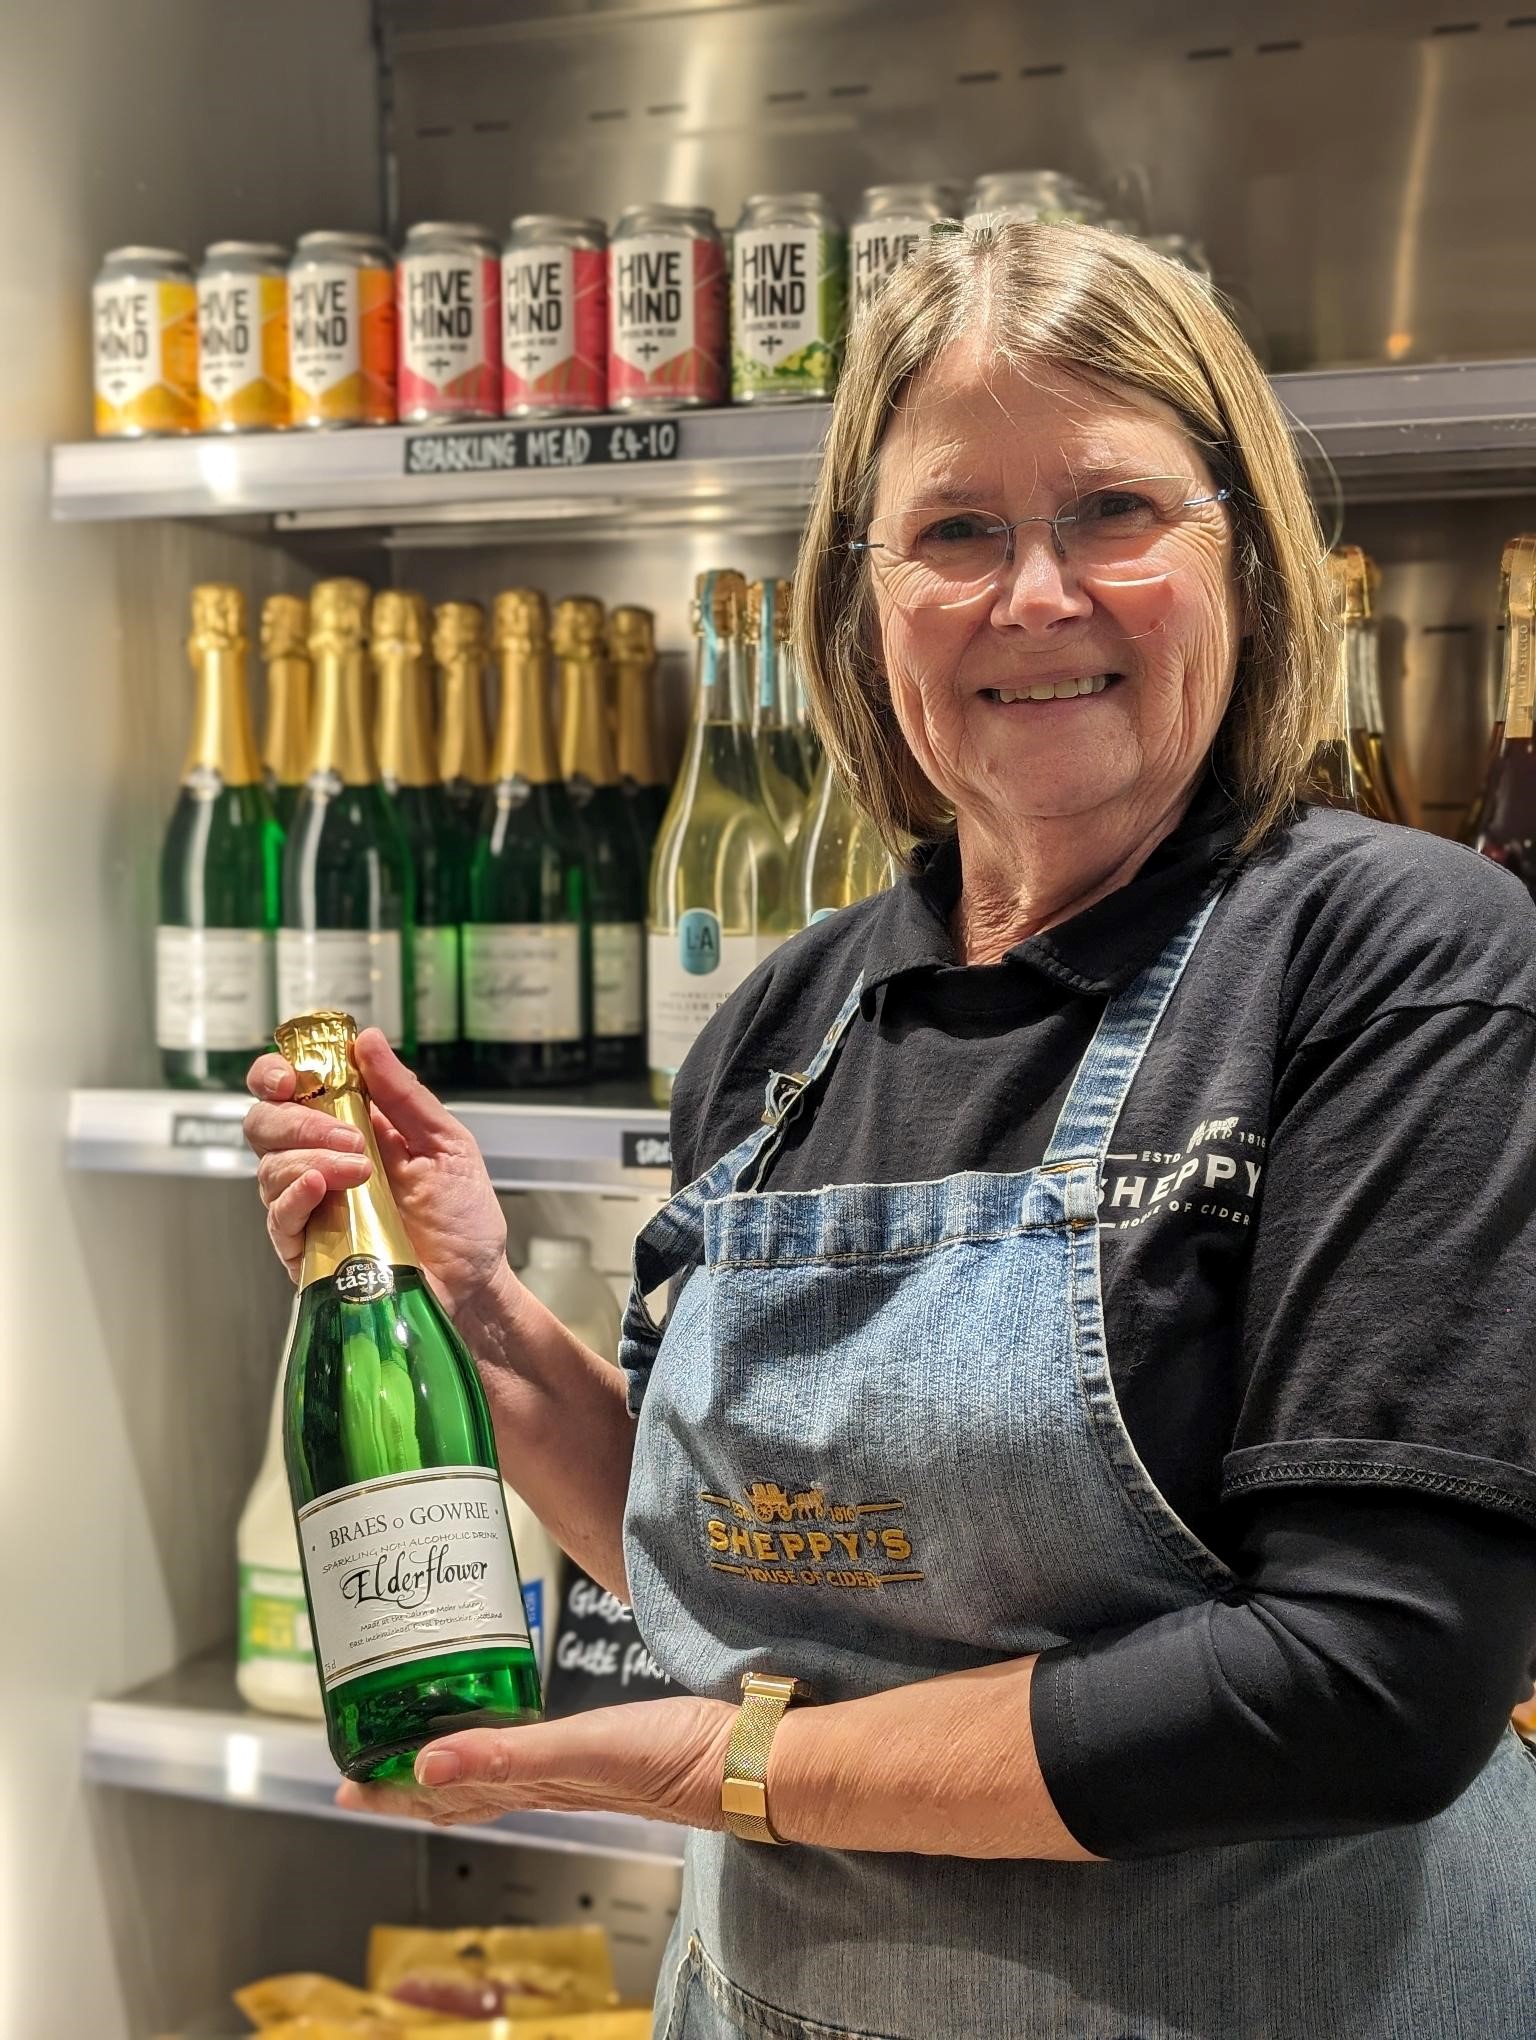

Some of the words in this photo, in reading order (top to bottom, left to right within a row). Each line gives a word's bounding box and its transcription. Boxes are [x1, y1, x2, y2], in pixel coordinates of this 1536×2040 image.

[618, 251, 681, 289] HIVE
[742, 242, 806, 281] HIVE
[409, 270, 472, 305] HIVE
[508, 262, 562, 300] HIVE
[742, 279, 806, 320] MIND
[409, 304, 472, 340] MIND
[618, 288, 681, 326] MIND
[409, 432, 516, 471] SPARKLING
[526, 428, 591, 466] MEAD
[1239, 1131, 1266, 1149] 1816
[1168, 1200, 1193, 1213] OF
[1201, 1204, 1250, 1226] CIDER
[335, 1270, 391, 1291] taste
[345, 1262, 376, 1276] great
[328, 1514, 388, 1549] BRAES
[409, 1502, 490, 1526] GOWRIE
[707, 1519, 913, 1562] SHEPPY'S
[322, 1550, 378, 1574] SPARKLING
[380, 1541, 407, 1553] NON
[409, 1531, 471, 1548] ALCOHOLIC
[471, 1531, 499, 1541] DRINK
[339, 1543, 488, 1609] Elderflower
[744, 1566, 799, 1586] HOUSE
[800, 1569, 822, 1586] OF
[825, 1570, 880, 1590] CIDER
